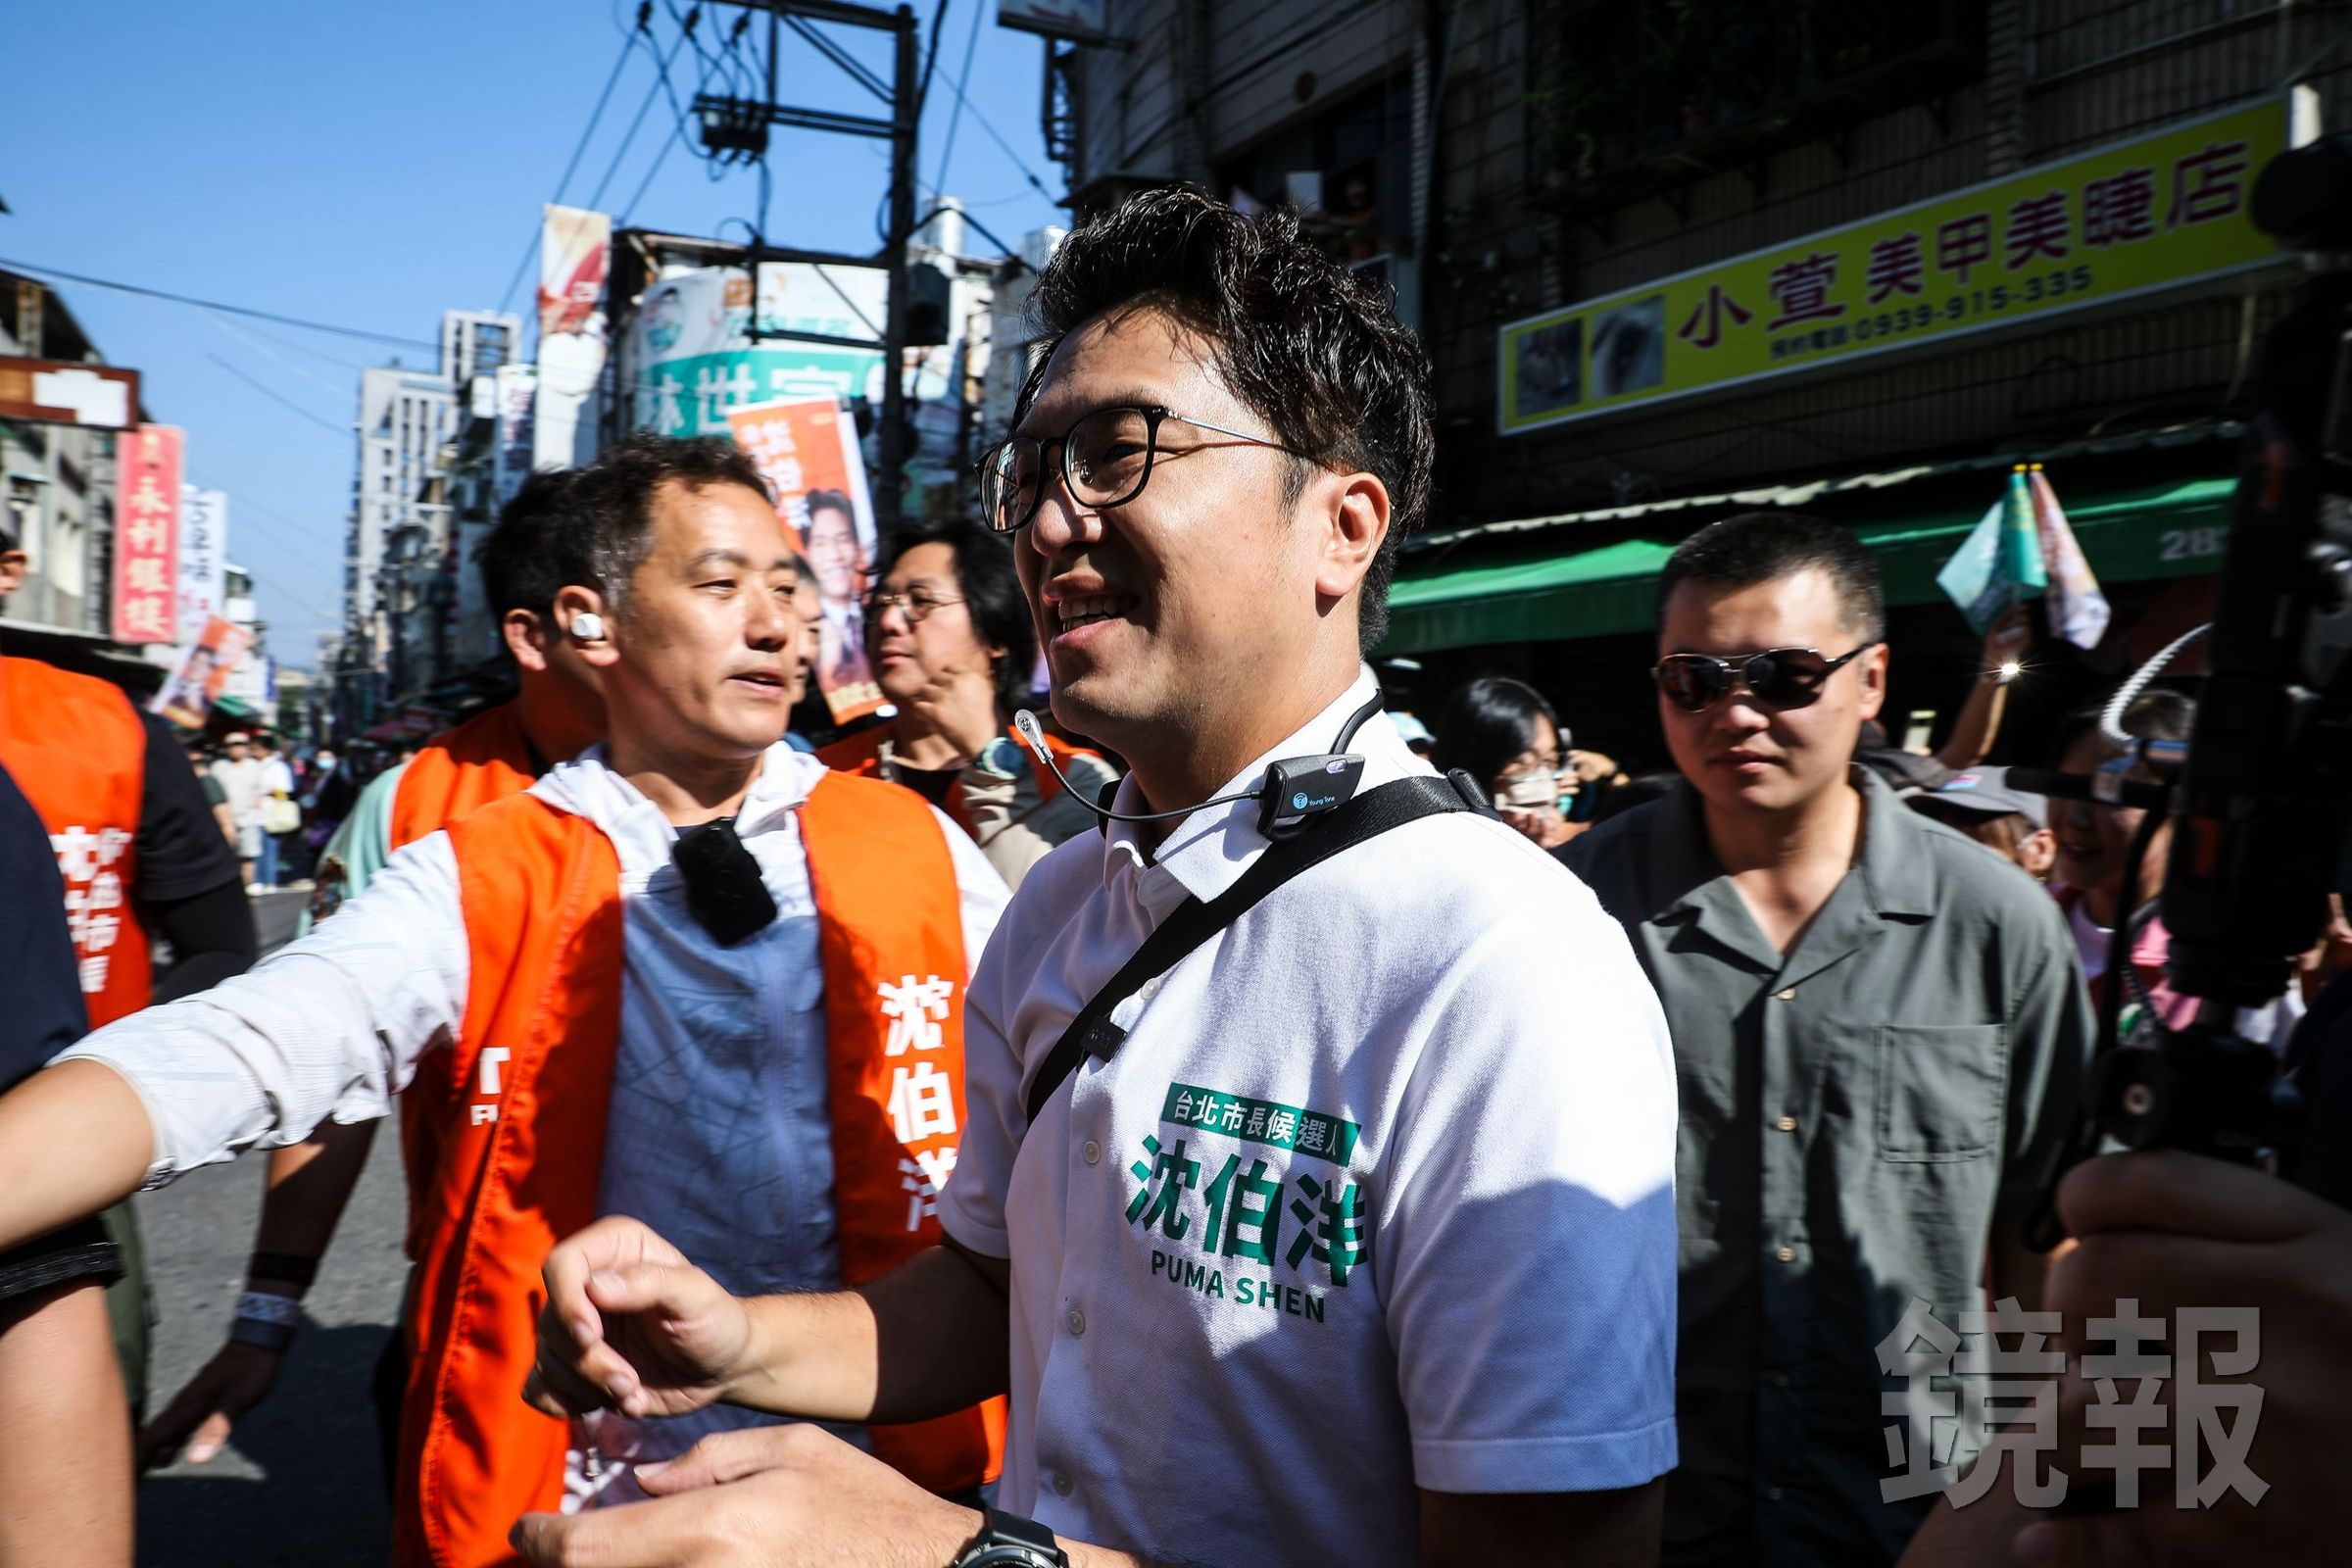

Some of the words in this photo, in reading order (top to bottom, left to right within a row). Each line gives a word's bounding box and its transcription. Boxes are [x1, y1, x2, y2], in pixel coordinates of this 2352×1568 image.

[1174, 1090, 1339, 1157] 台北市長候選人
[1125, 1134, 1369, 1288] 沈伯洋
[1151, 1249, 1225, 1299] PUMA
[1235, 1276, 1325, 1324] SHEN
